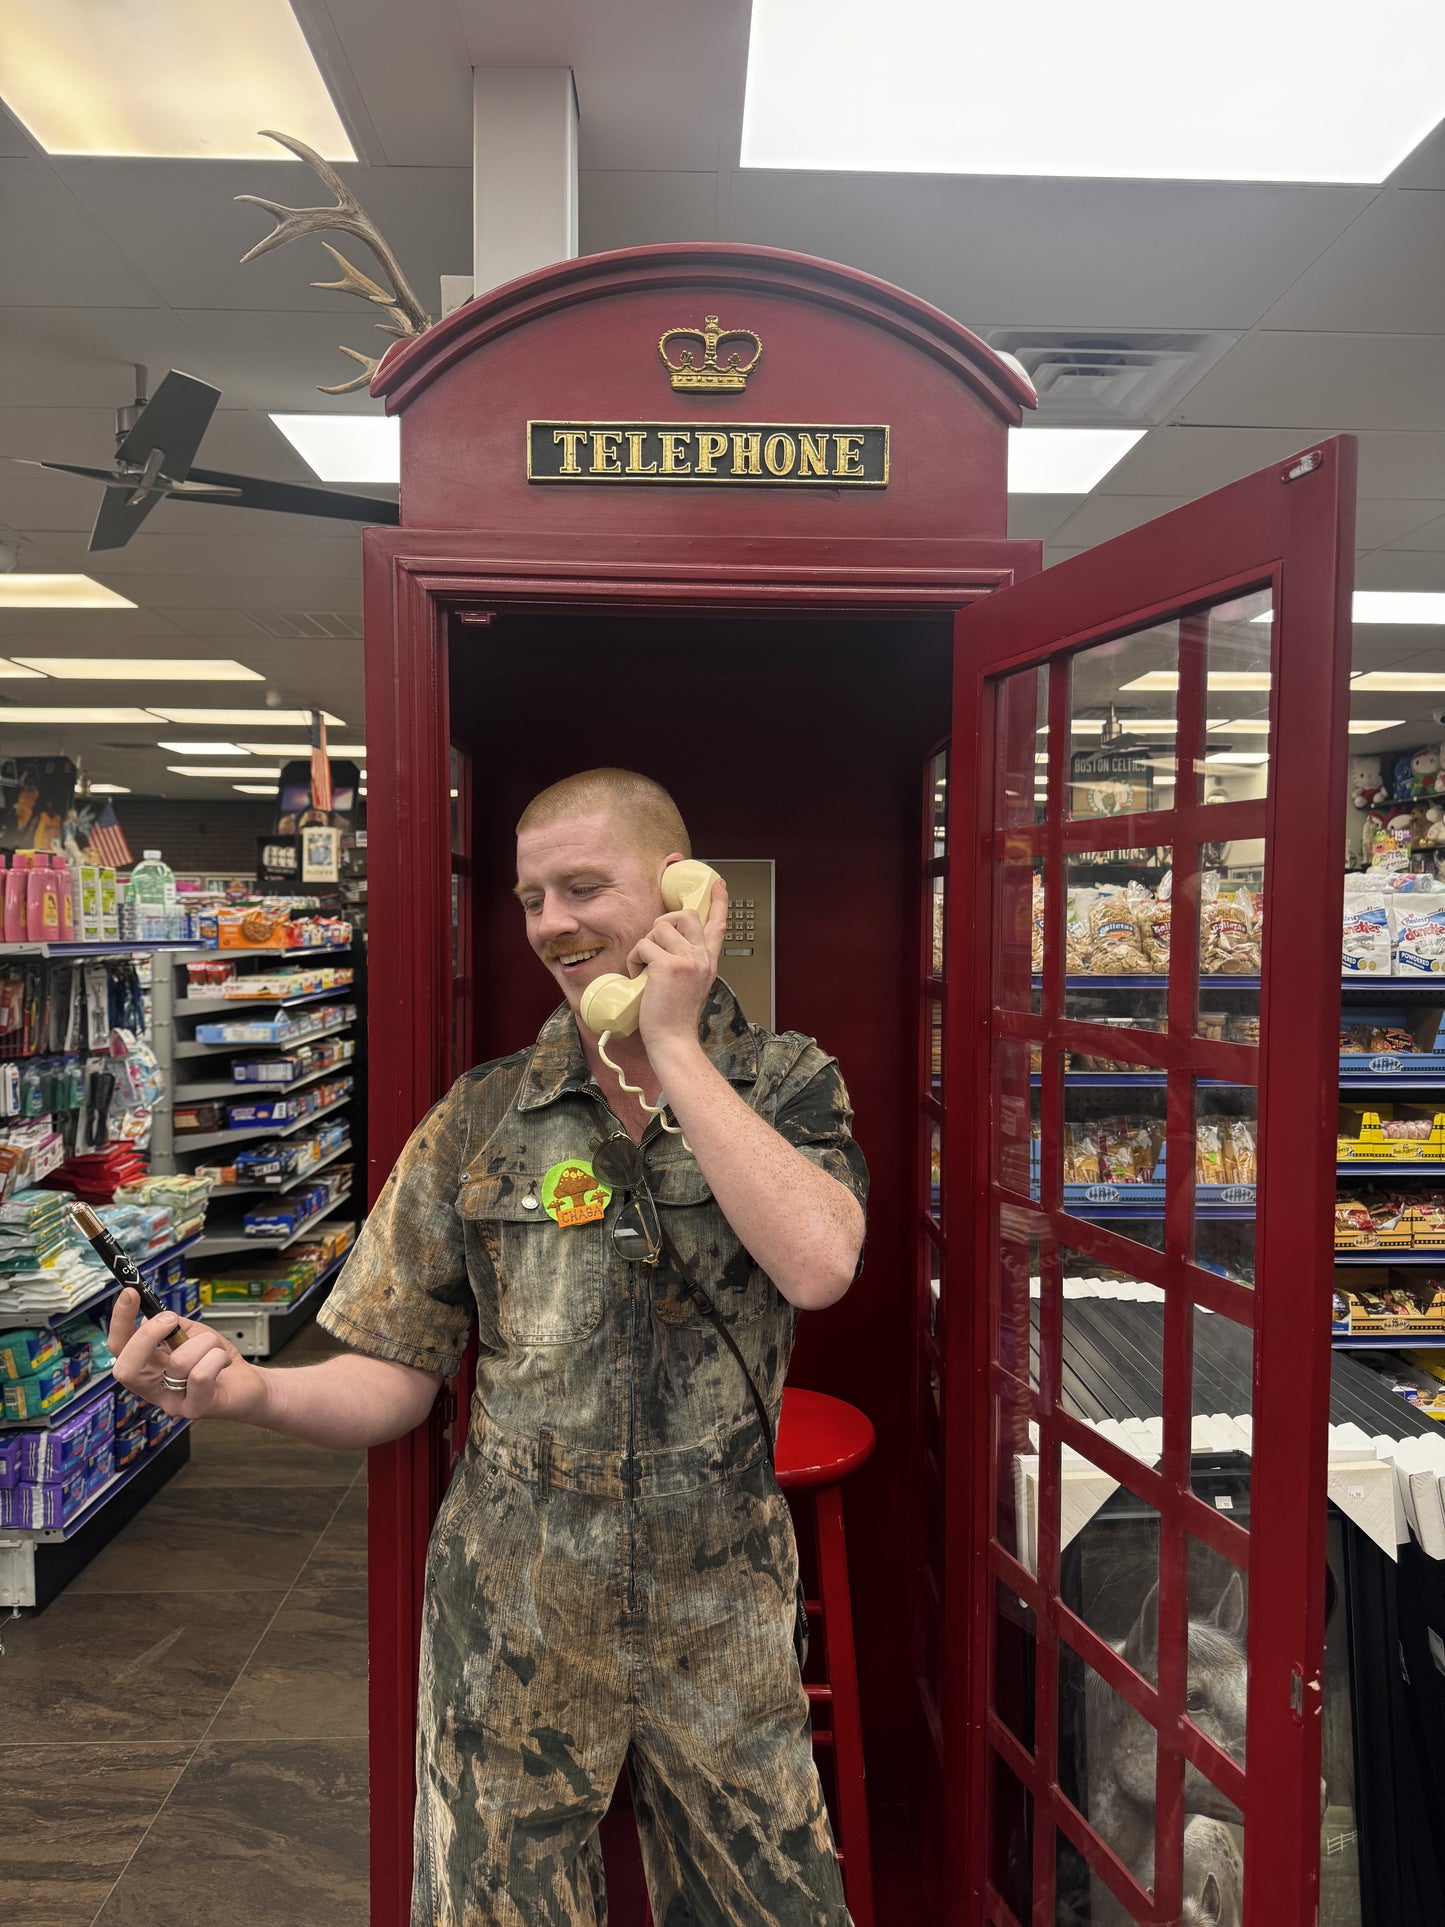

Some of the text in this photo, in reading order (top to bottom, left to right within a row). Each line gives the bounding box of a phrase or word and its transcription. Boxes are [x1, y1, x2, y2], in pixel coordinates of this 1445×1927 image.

[553, 430, 865, 477] TELEPHONE
[1074, 757, 1147, 773] BOSTON CELTICS
[1401, 952, 1430, 967] POWDERED
